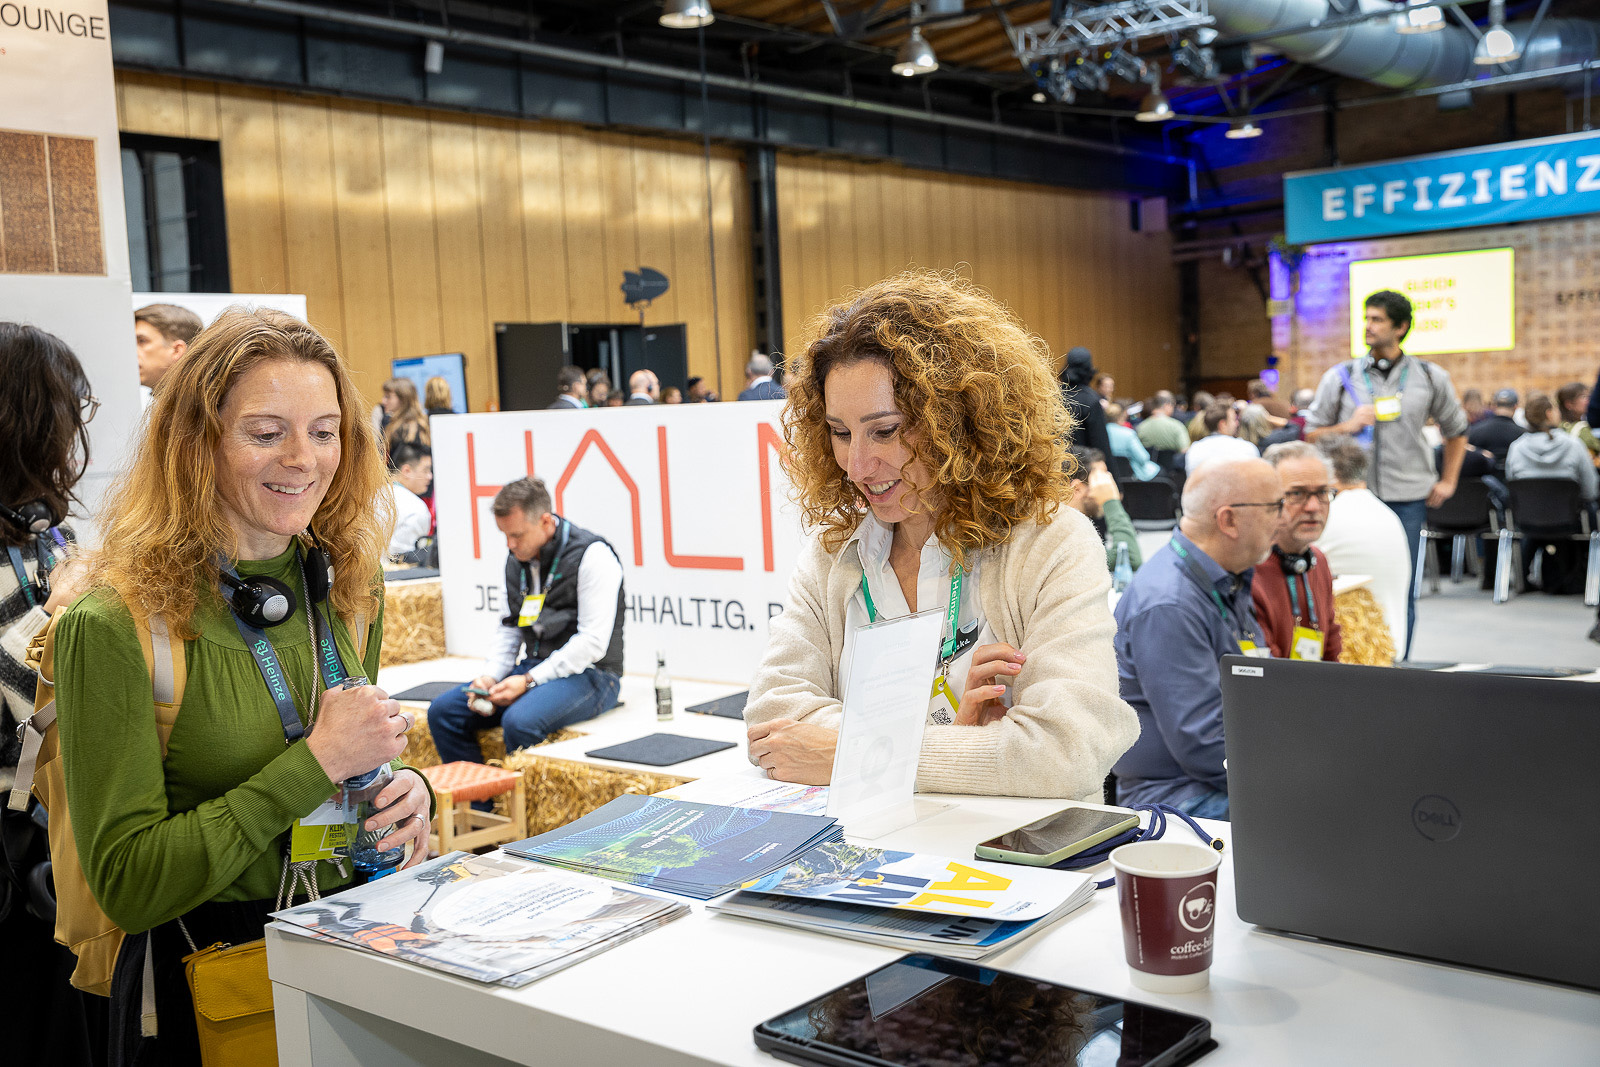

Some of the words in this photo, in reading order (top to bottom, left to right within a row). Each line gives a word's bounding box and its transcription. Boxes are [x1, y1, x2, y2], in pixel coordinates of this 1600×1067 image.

[0, 3, 105, 40] OUNGE
[1322, 154, 1600, 222] EFFIZIENZ
[475, 585, 500, 612] JE
[624, 594, 754, 631] HHALTIG.
[950, 579, 960, 621] Heinze
[261, 655, 286, 701] Heinze
[320, 638, 343, 684] Heinze
[329, 824, 346, 832] KLIM
[1418, 810, 1456, 827] DELL
[1170, 934, 1213, 955] coffee-bi
